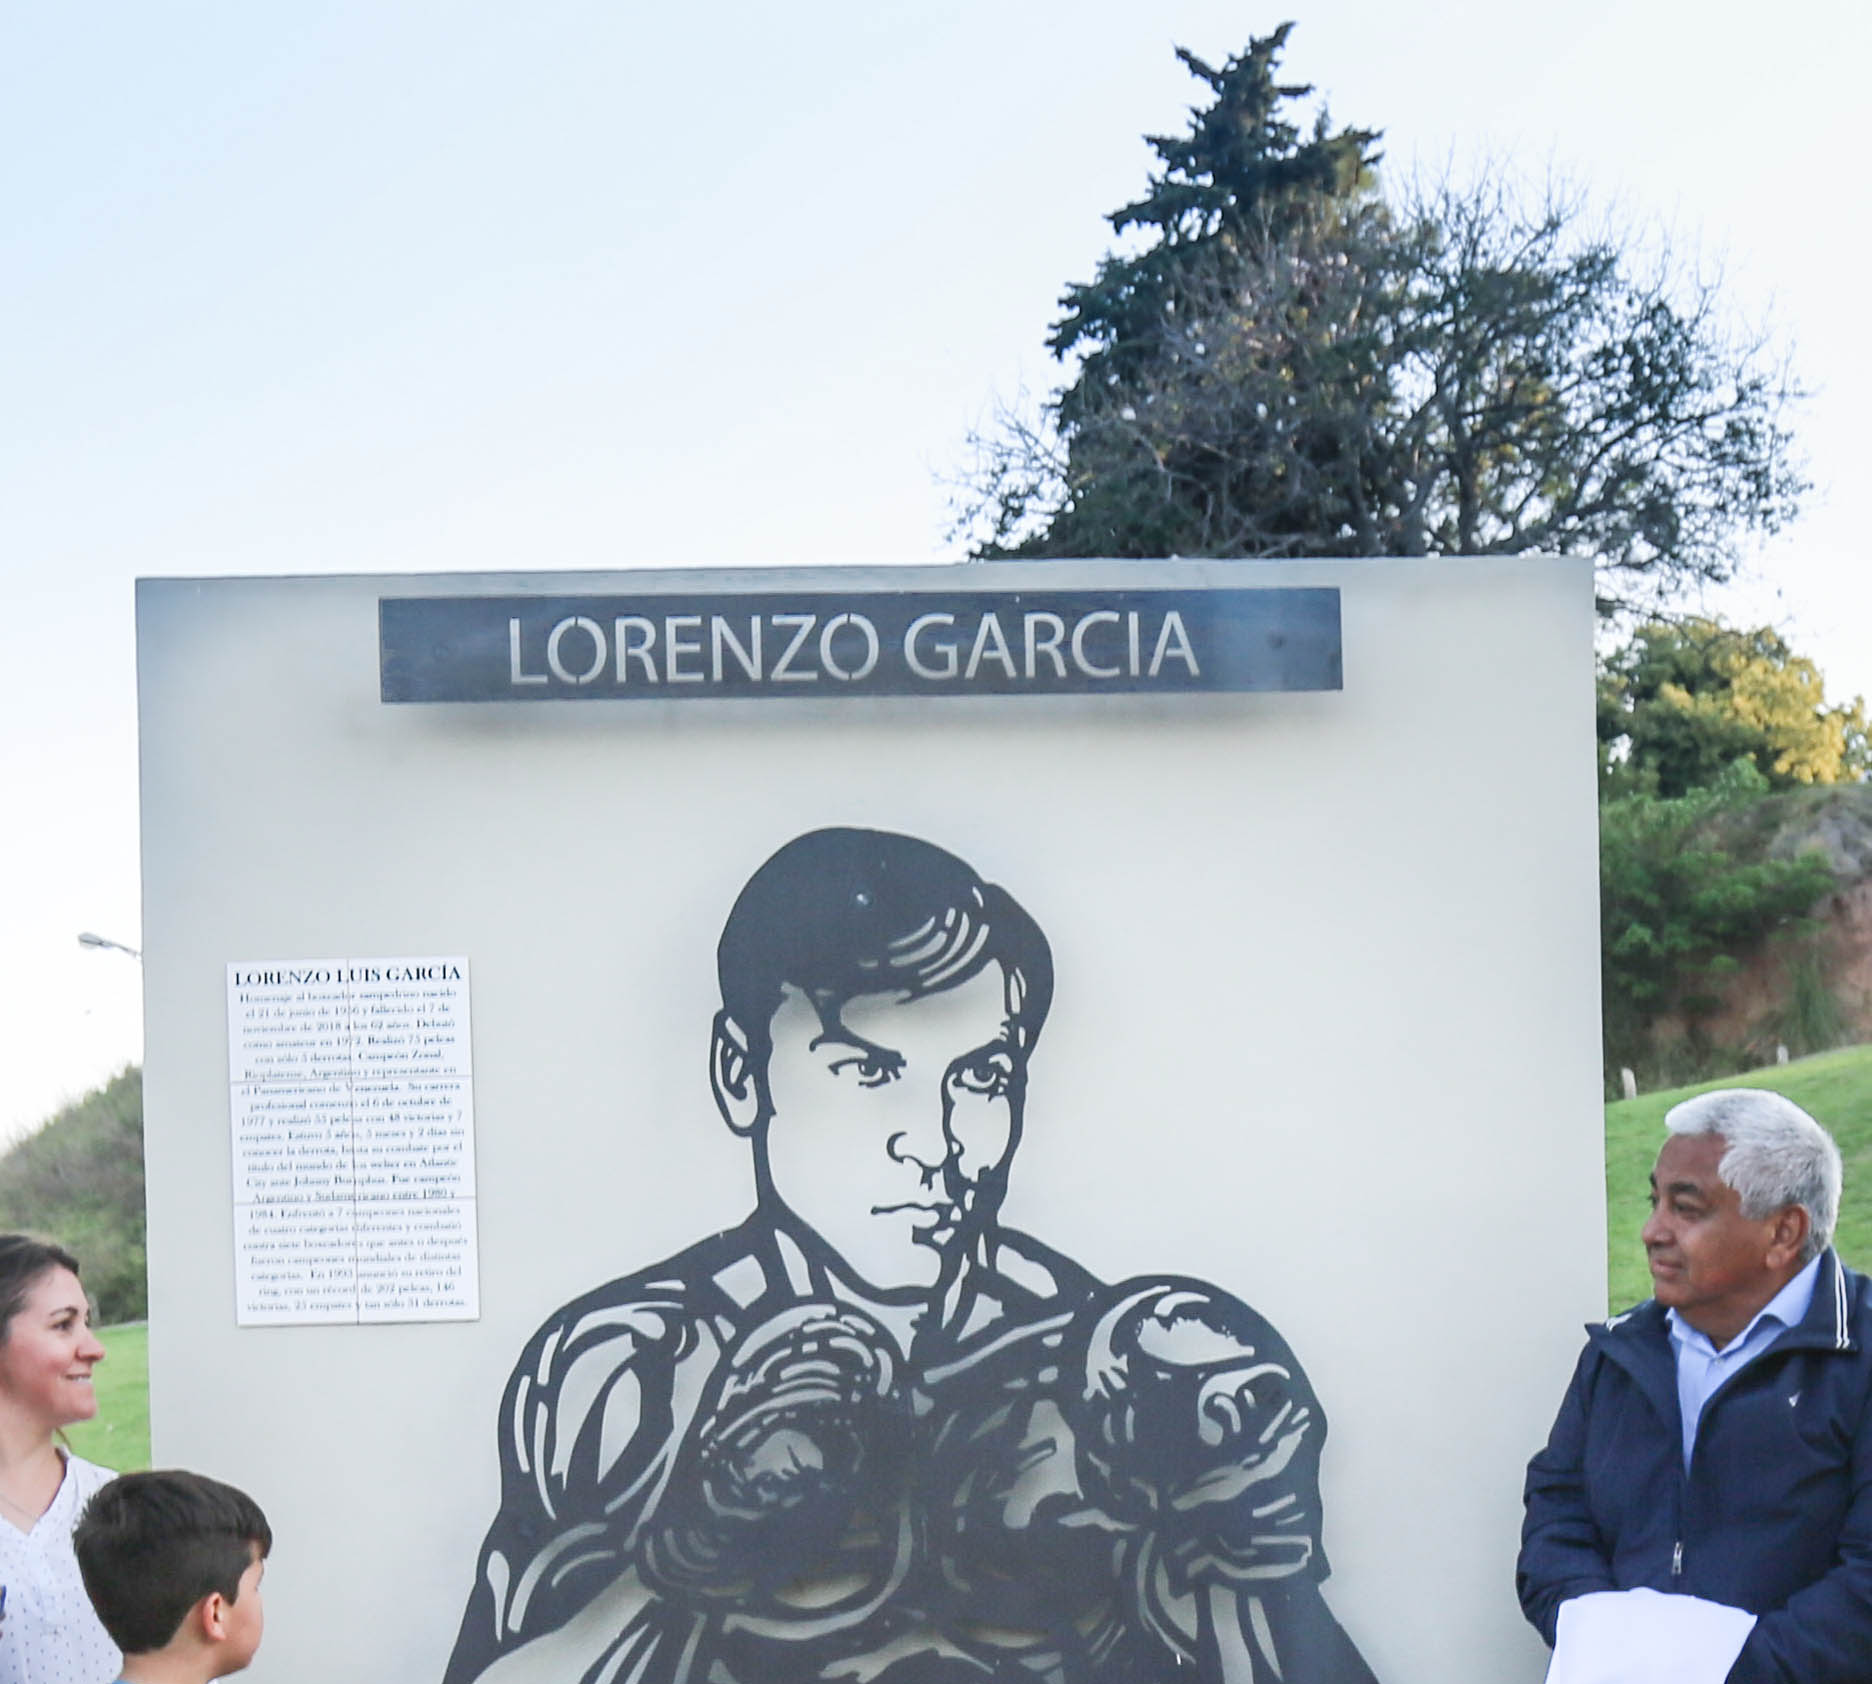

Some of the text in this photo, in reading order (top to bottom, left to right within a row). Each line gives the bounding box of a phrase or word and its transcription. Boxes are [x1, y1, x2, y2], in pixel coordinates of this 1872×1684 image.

[508, 610, 1201, 685] LORENZO GARCIA
[234, 963, 460, 986] LORENZO LUIS GARCÍA
